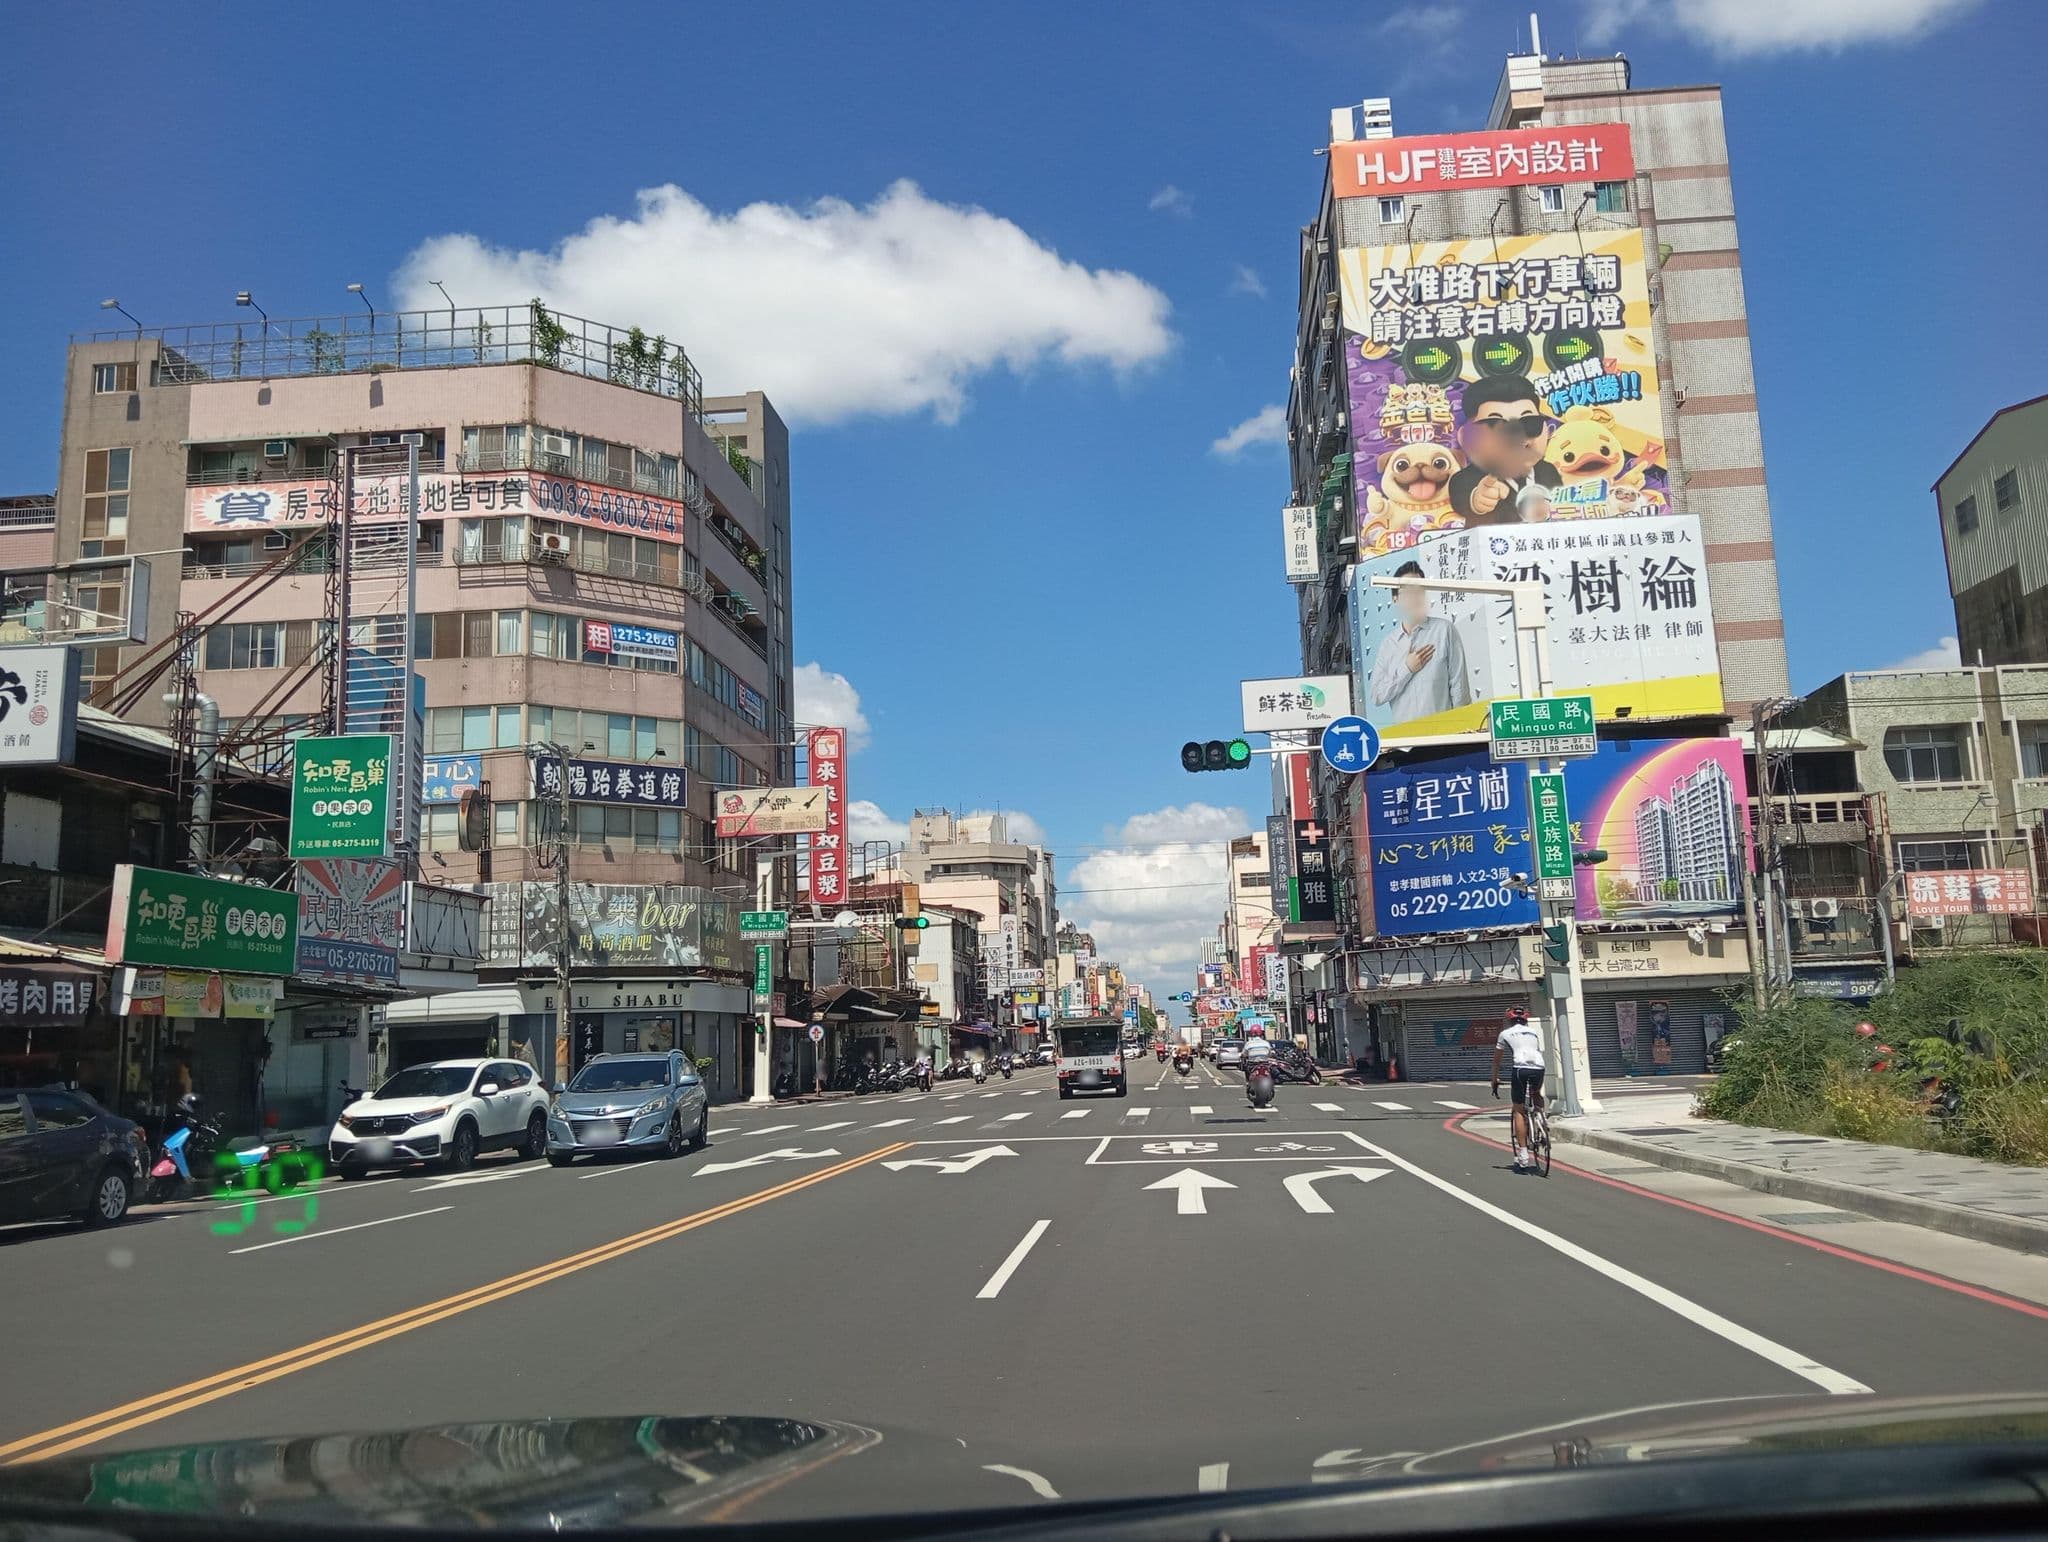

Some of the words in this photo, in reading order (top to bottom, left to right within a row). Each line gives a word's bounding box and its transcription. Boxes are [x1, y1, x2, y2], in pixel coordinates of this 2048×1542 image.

[1357, 149, 1437, 185] HJF
[1438, 148, 1457, 181] 建築
[1458, 138, 1603, 179] 室內設計
[1370, 254, 1618, 306] 大雅路下行車輛
[1371, 296, 1622, 343] 請注意右轉方向燈
[216, 492, 271, 523] 貸
[538, 478, 676, 536] 0932-980274
[1514, 530, 1692, 552] 嘉義市東區市議員參選人
[1438, 543, 1451, 614] 我就在裡!
[1568, 623, 1652, 645] 臺大法律
[1664, 620, 1704, 639] 律師
[1259, 692, 1313, 712] 鮮茶道
[1502, 702, 1582, 722] 民國路
[1511, 723, 1555, 734] Minguo
[1559, 721, 1576, 730] Rd.
[303, 759, 385, 793] 知更鳥巢
[542, 762, 681, 802] 朝陽跆拳道館
[1540, 778, 1555, 787] W.
[1415, 767, 1510, 822] 星空樹
[1542, 807, 1563, 862] 民族路
[1391, 903, 1408, 917] 05
[1412, 886, 1512, 915] 229-2200
[1916, 905, 1940, 914] LOVE
[1944, 904, 1969, 913] YOUR
[1973, 903, 2004, 912] SHOES
[138, 888, 219, 950] 知更鳥巢
[226, 907, 286, 940] 鮮果茶飲
[329, 949, 396, 973] 05-2765771
[1528, 959, 1603, 974] 台哥大
[545, 996, 589, 1009] EU
[613, 993, 684, 1007] SHABU
